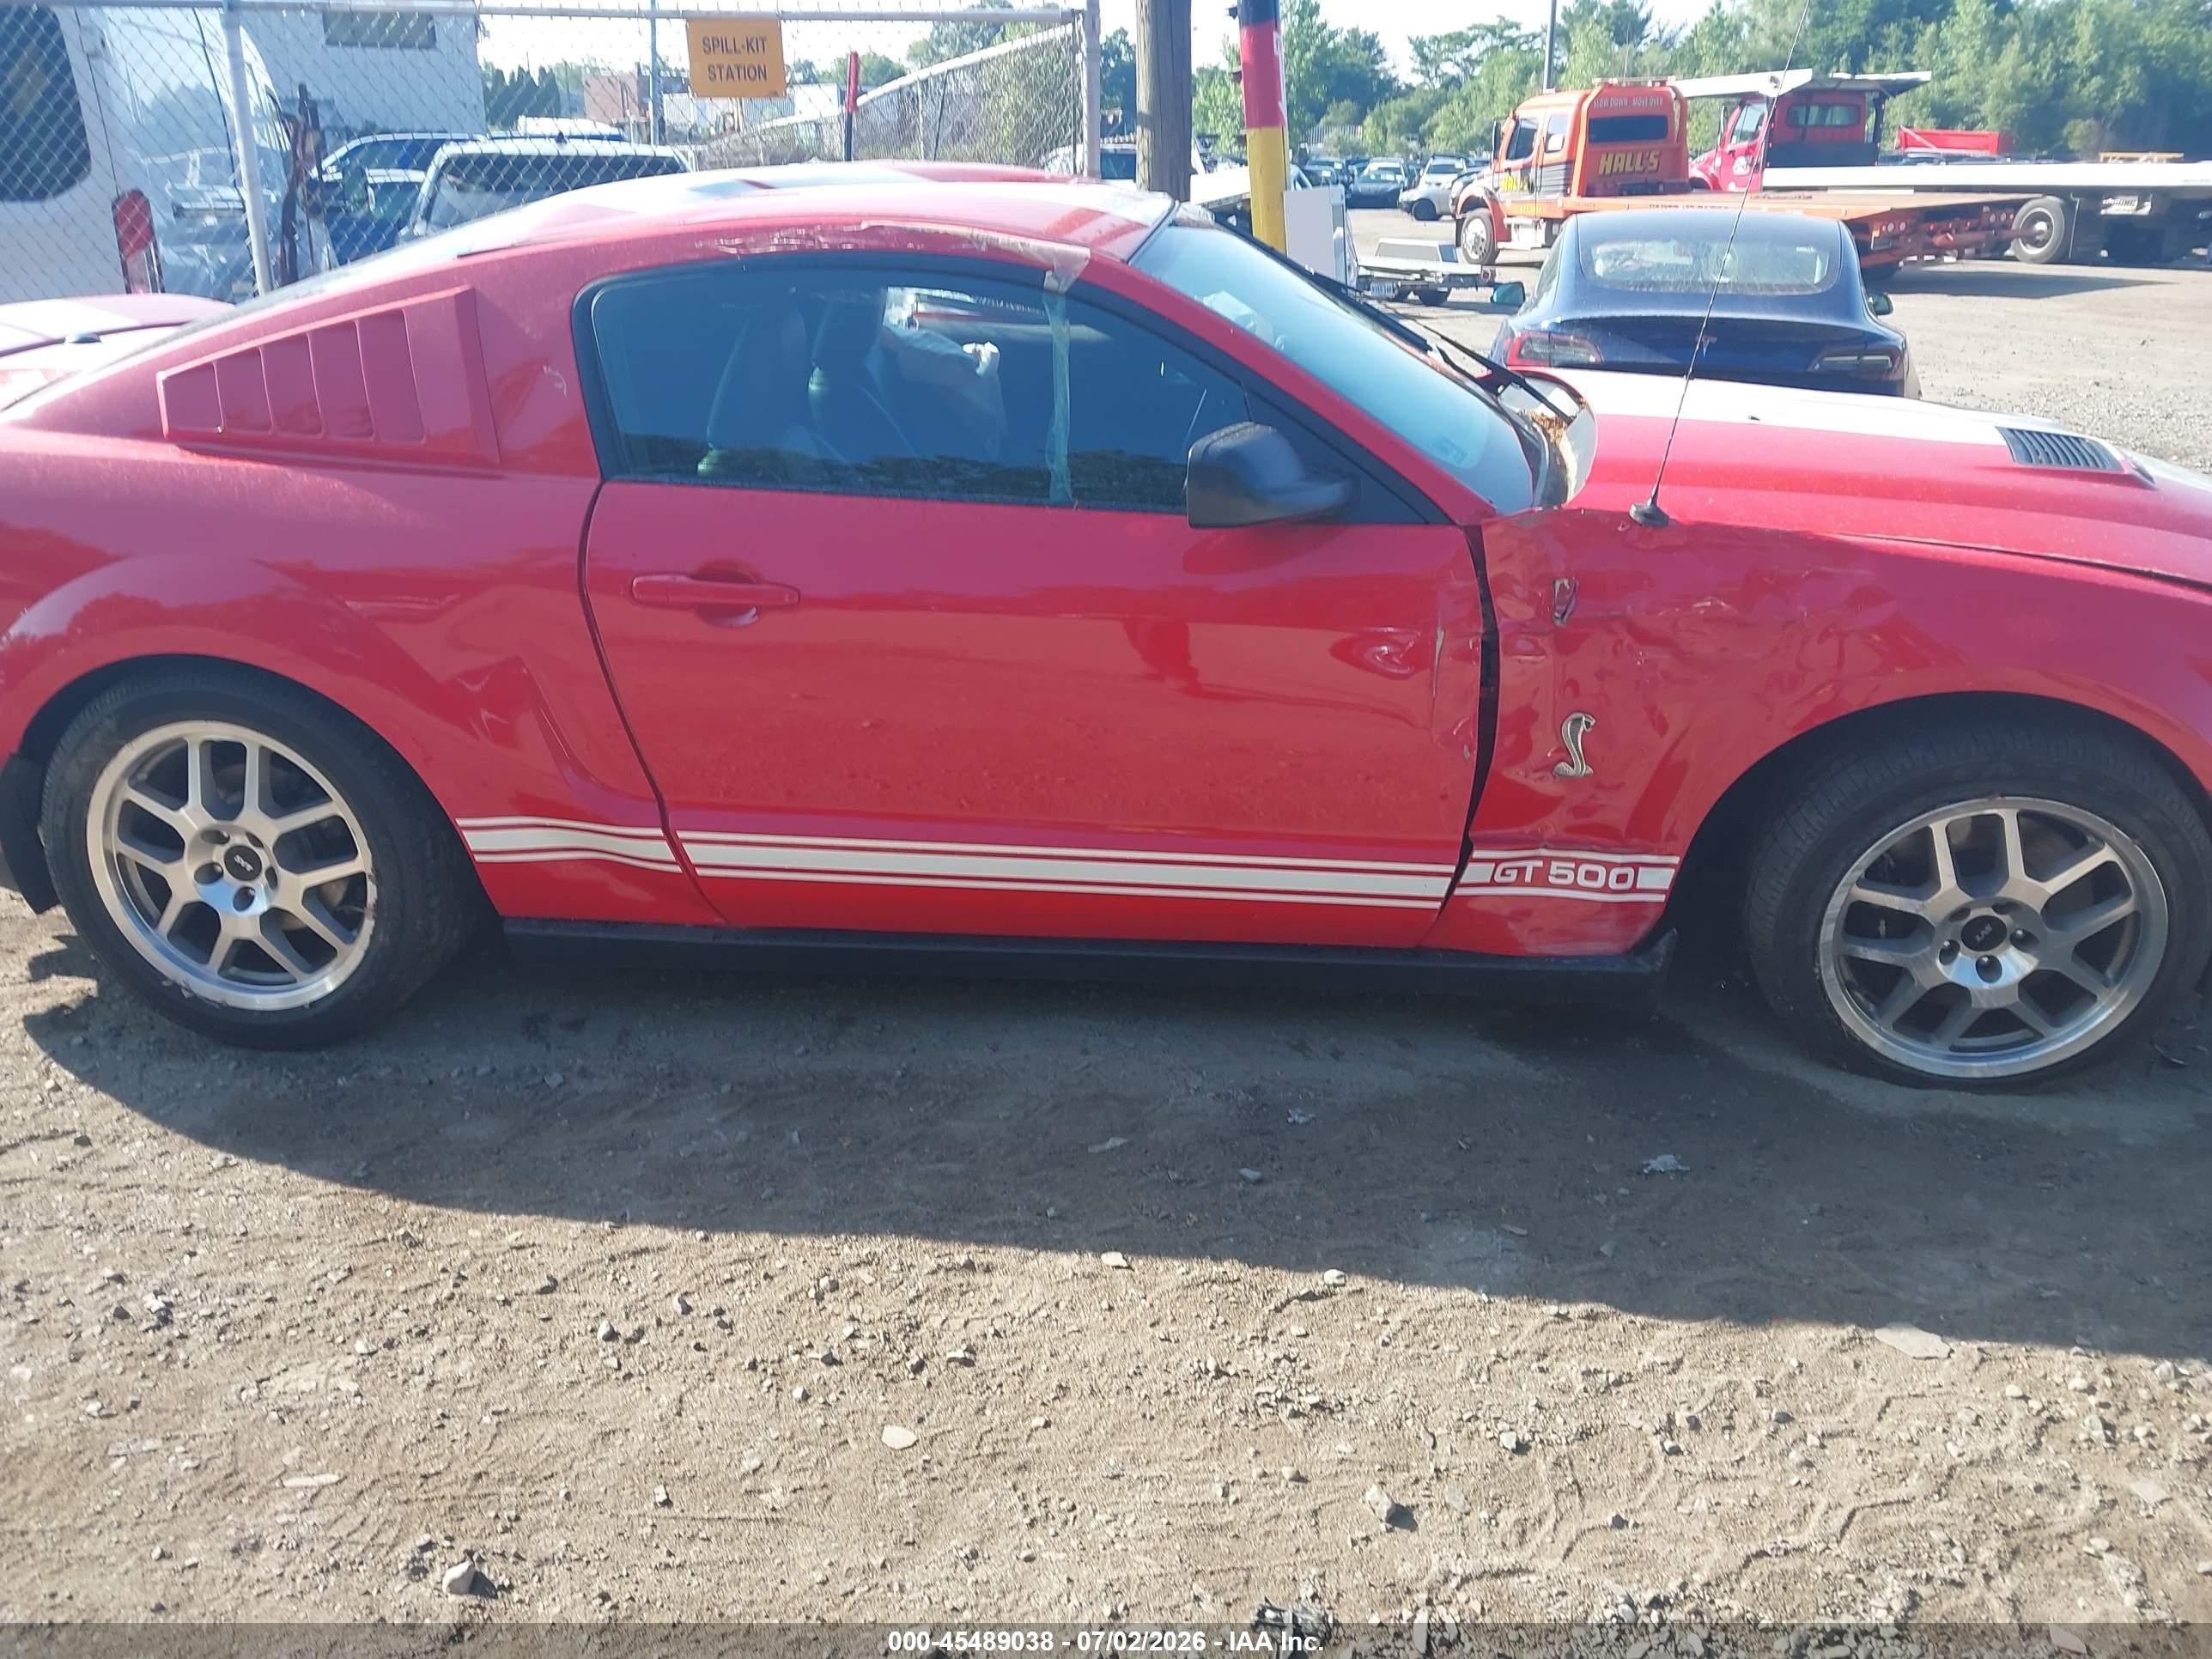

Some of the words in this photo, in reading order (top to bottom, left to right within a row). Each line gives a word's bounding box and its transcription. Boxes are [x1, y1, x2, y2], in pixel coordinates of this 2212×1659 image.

[702, 35, 768, 54] SPILL-KIT
[708, 64, 767, 82] STATION
[1594, 96, 1609, 109] SLOW
[1610, 96, 1628, 108] DOWN
[1632, 95, 1648, 107] MOVE
[1599, 150, 1661, 175] HALL'S
[1493, 860, 1544, 884] GT
[1548, 860, 1636, 891] 500
